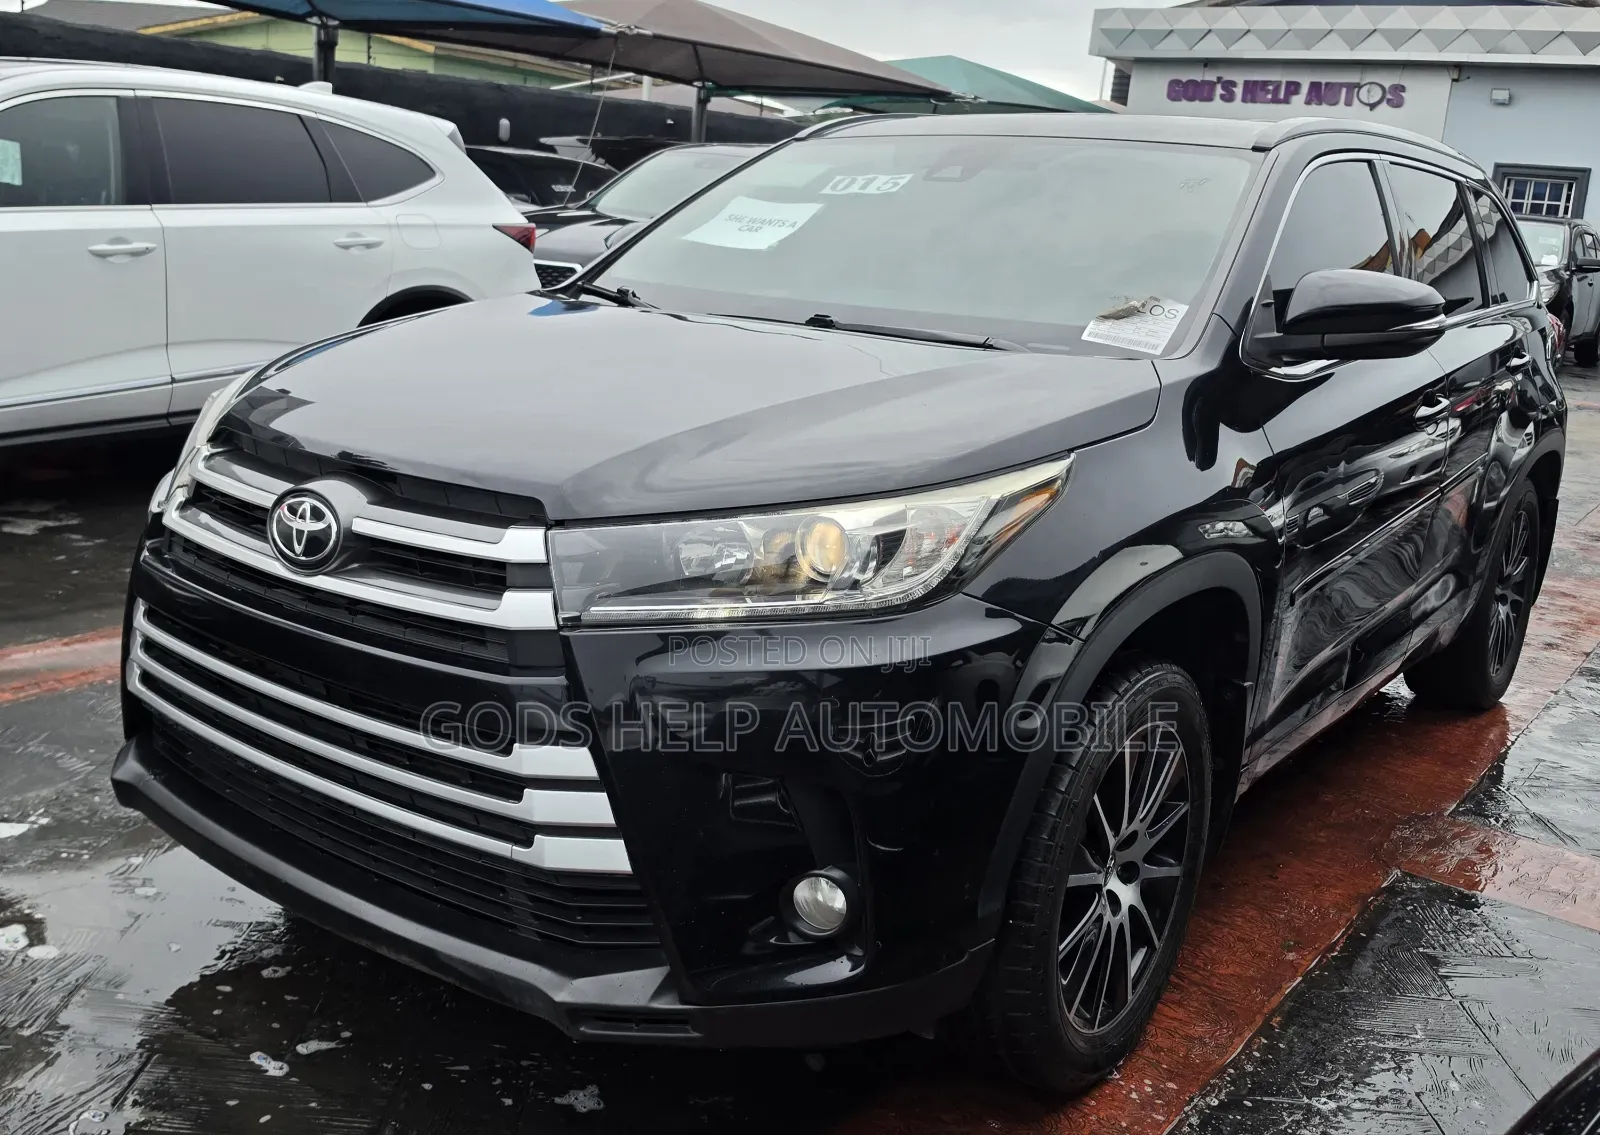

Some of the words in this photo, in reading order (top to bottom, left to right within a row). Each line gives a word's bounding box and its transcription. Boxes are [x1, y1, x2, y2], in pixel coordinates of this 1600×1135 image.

[1166, 76, 1238, 102] GOD'S
[1241, 79, 1302, 104] HELP
[1304, 81, 1406, 111] AUTOS
[830, 175, 908, 192] 015
[724, 213, 749, 224] SHE
[750, 216, 787, 229] WANTS
[787, 220, 798, 229] A
[737, 223, 763, 233] CAR
